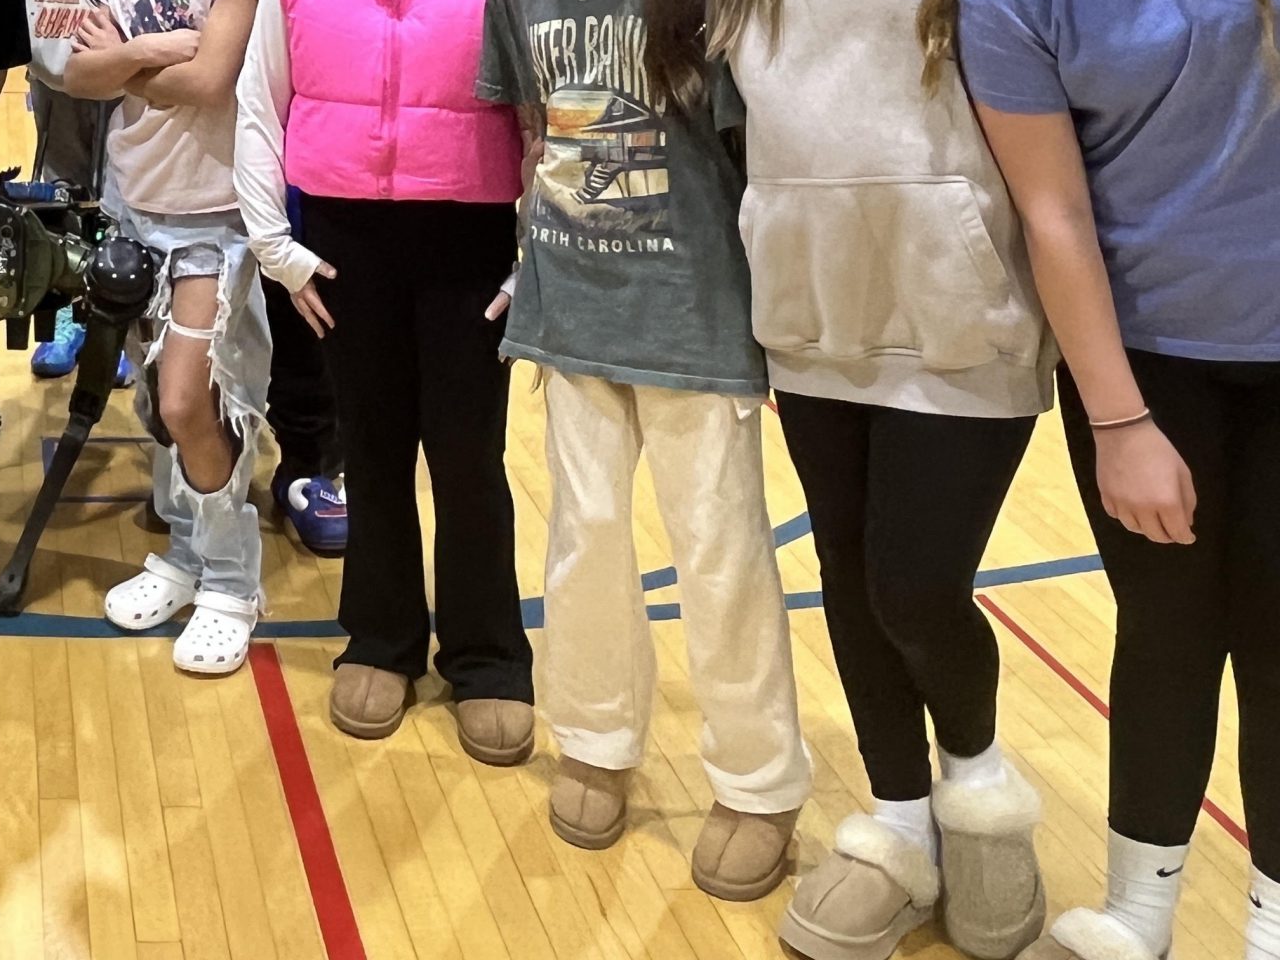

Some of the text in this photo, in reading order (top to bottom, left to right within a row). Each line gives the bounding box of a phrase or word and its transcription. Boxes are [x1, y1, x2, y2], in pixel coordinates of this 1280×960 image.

[529, 14, 667, 119] UTER BANK
[578, 235, 675, 253] CAROLINA
